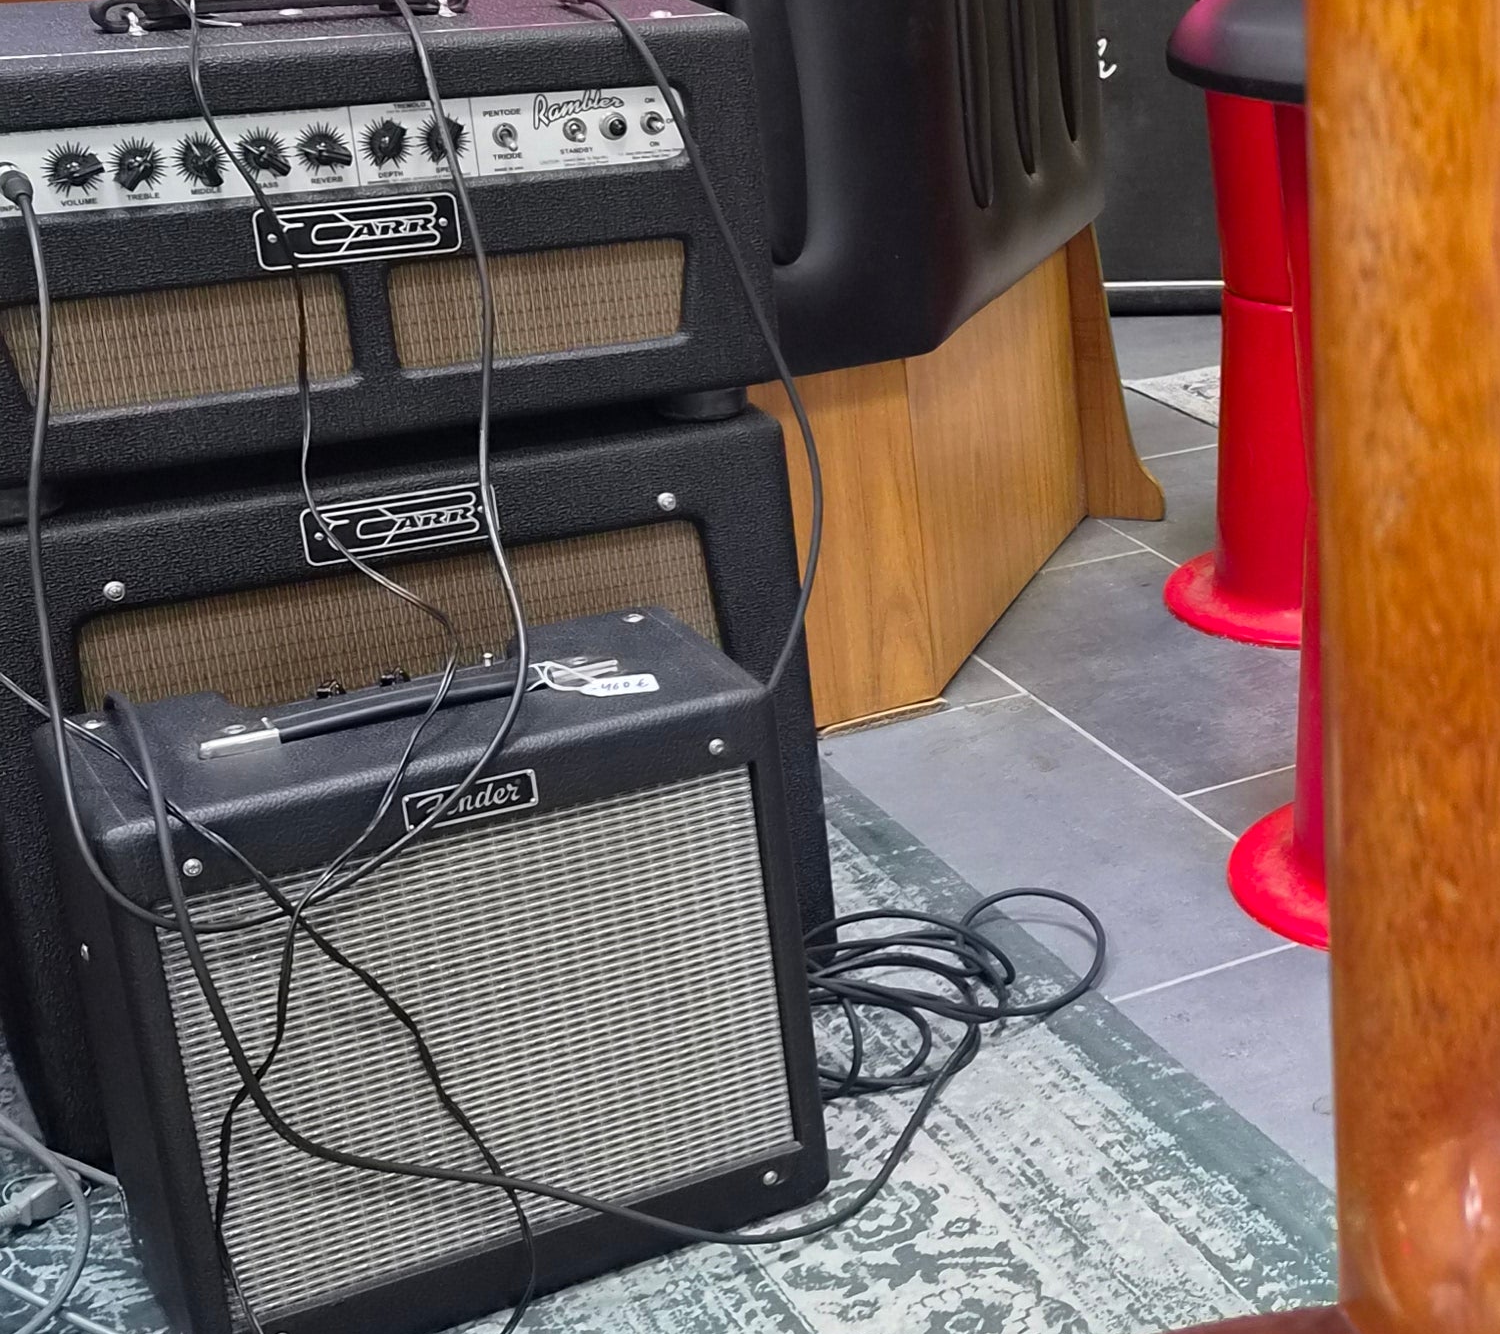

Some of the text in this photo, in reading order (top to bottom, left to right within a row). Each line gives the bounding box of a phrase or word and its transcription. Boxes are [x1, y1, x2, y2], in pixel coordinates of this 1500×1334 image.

[482, 107, 522, 118] PENTODE
[532, 88, 625, 130] Rambler
[649, 140, 660, 148] ON
[560, 146, 594, 155] STANDBY
[492, 151, 523, 161] TRIODE
[377, 170, 404, 179] DEPTH
[310, 175, 344, 186] REVERB
[126, 191, 161, 201] TREBLE
[190, 186, 223, 196] MIDDLE
[60, 197, 99, 207] VOLUME
